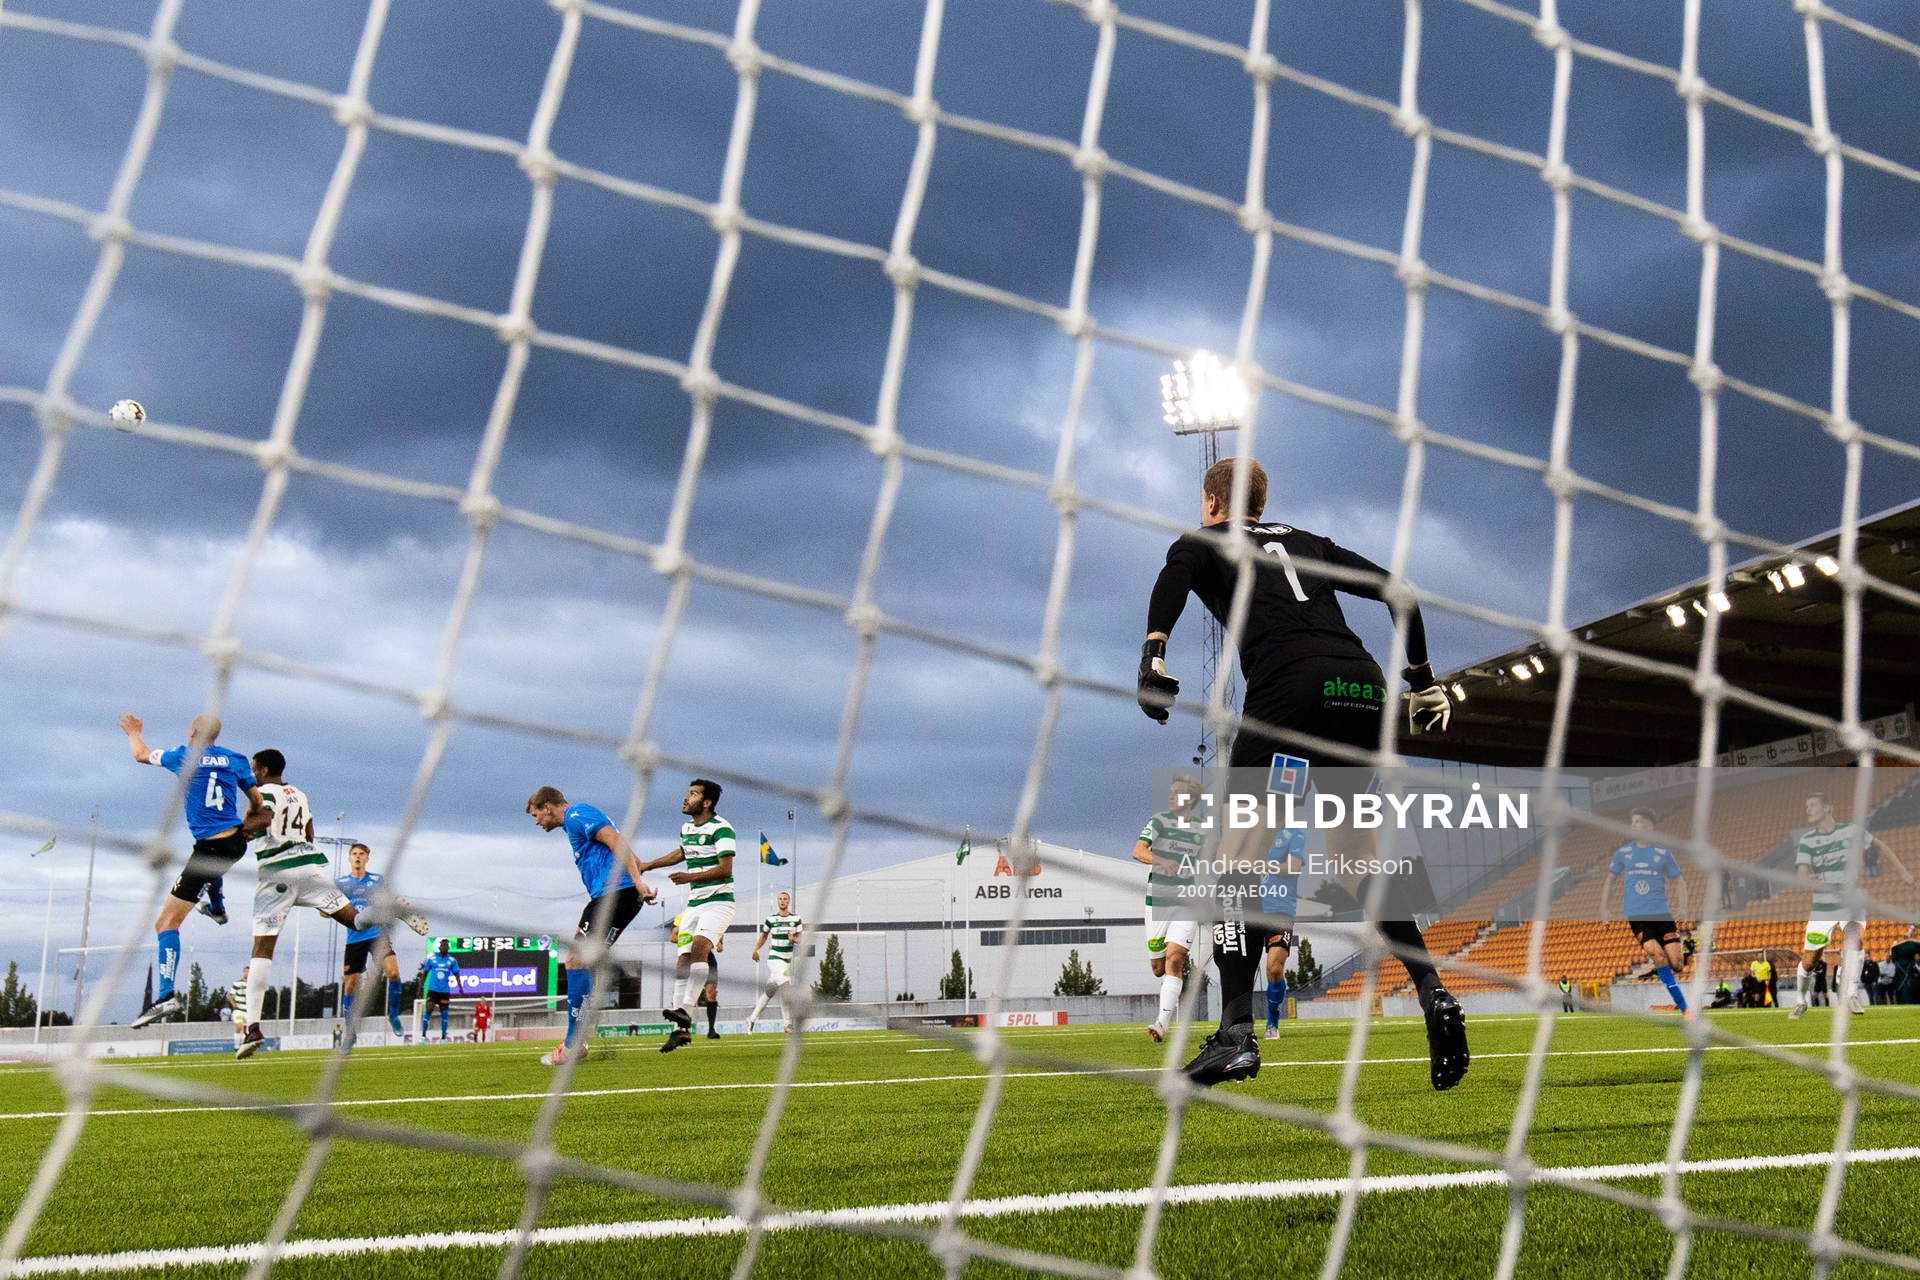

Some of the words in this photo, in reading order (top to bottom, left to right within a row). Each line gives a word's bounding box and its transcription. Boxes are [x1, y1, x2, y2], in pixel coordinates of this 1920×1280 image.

[1263, 541, 1309, 601] 1
[202, 756, 227, 766] EAB
[205, 771, 224, 811] 4
[281, 806, 304, 836] 14
[975, 885, 1011, 899] ABB
[1213, 923, 1224, 945] GN
[1007, 1013, 1039, 1026] SPOL
